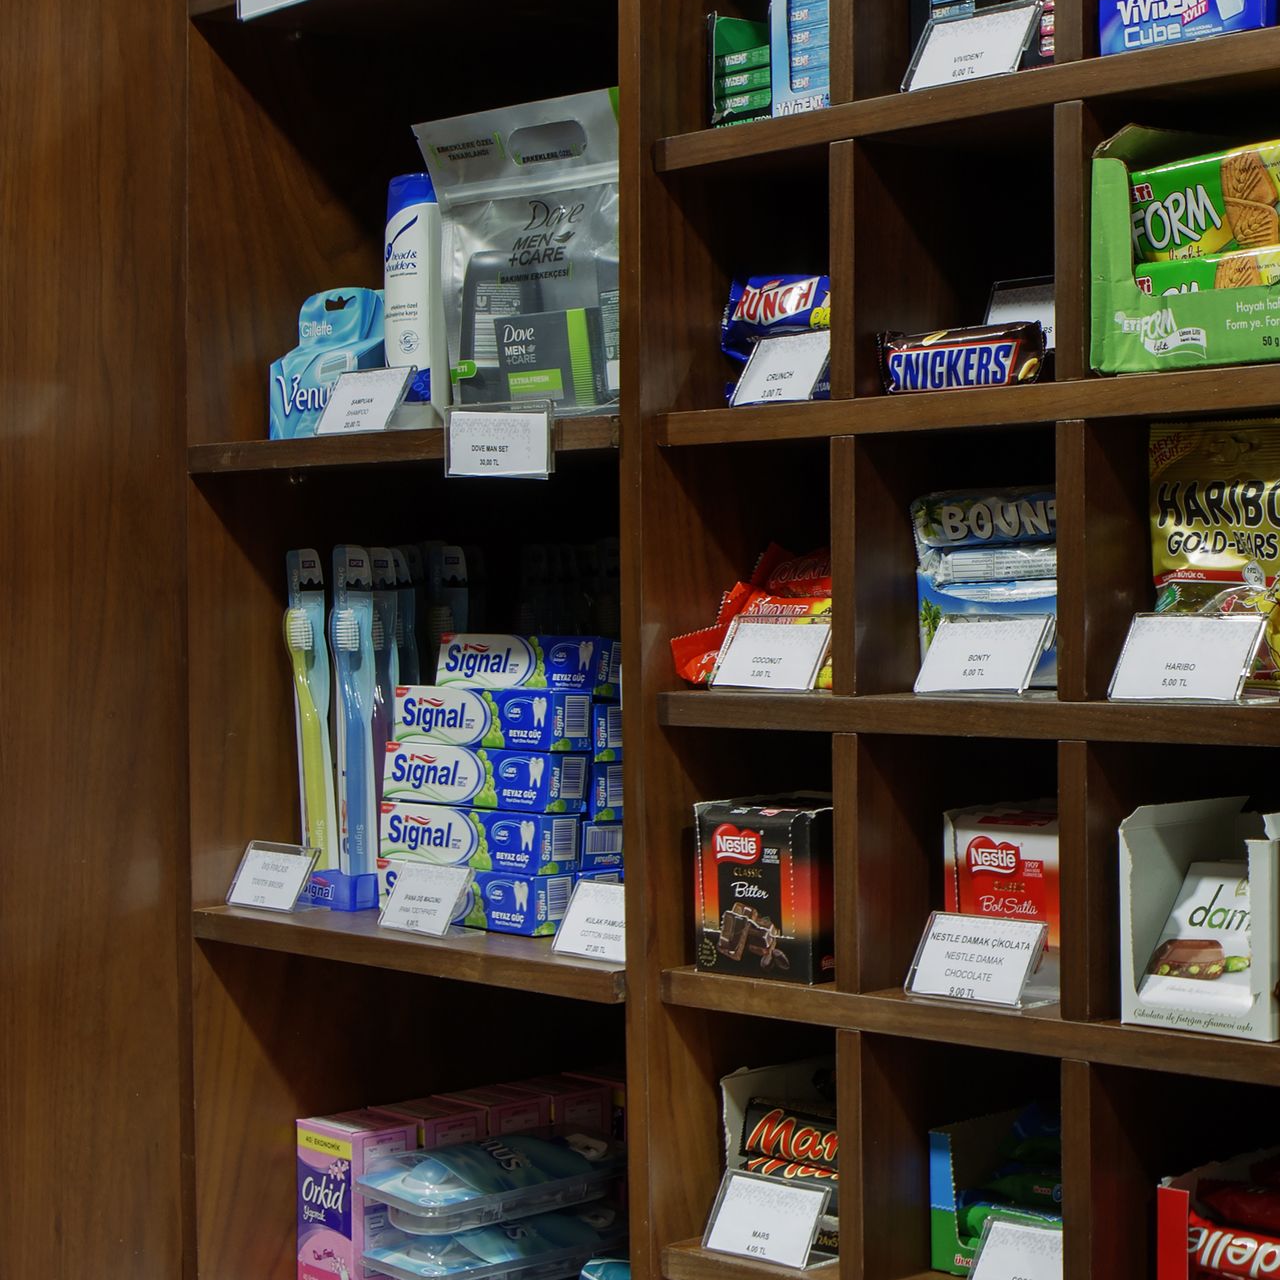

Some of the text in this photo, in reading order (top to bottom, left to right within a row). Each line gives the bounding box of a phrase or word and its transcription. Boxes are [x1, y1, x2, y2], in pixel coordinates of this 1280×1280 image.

[1182, 1, 1208, 26] XYLIT
[1124, 22, 1181, 48] Cube
[523, 200, 584, 231] Dove
[1132, 184, 1222, 260] FORM
[512, 232, 554, 251] MEN
[509, 246, 566, 267] +CARE
[301, 321, 333, 337] Gillette
[503, 325, 535, 343] Dove
[505, 345, 526, 356] MEN
[766, 371, 794, 382] CRUNCH
[890, 344, 1012, 390] SNICKERS
[471, 444, 509, 453] DOVE MAN SET
[445, 644, 511, 678] Signal
[752, 656, 782, 665] COCONUT
[967, 654, 991, 662] BONTY
[1165, 662, 1196, 671] HARIBO
[1162, 678, 1187, 687] 5,00 TL
[402, 696, 466, 733] Signal
[509, 728, 542, 740] BEYAZ GÜÇ
[392, 752, 459, 789] Signal
[550, 766, 560, 797] Signal
[388, 815, 453, 851] Signal
[542, 830, 551, 861] Signal
[733, 867, 763, 878] CLASSIC
[730, 881, 768, 900] Bitter
[537, 889, 546, 921] Signal
[930, 931, 1031, 952] NESTLE DAMAK ÇİKOLATA
[945, 951, 1004, 966] NESTLE DAMAK
[945, 968, 992, 983] CHOCOLATE
[302, 1176, 345, 1213] Orkid
[752, 1230, 770, 1240] MARS
